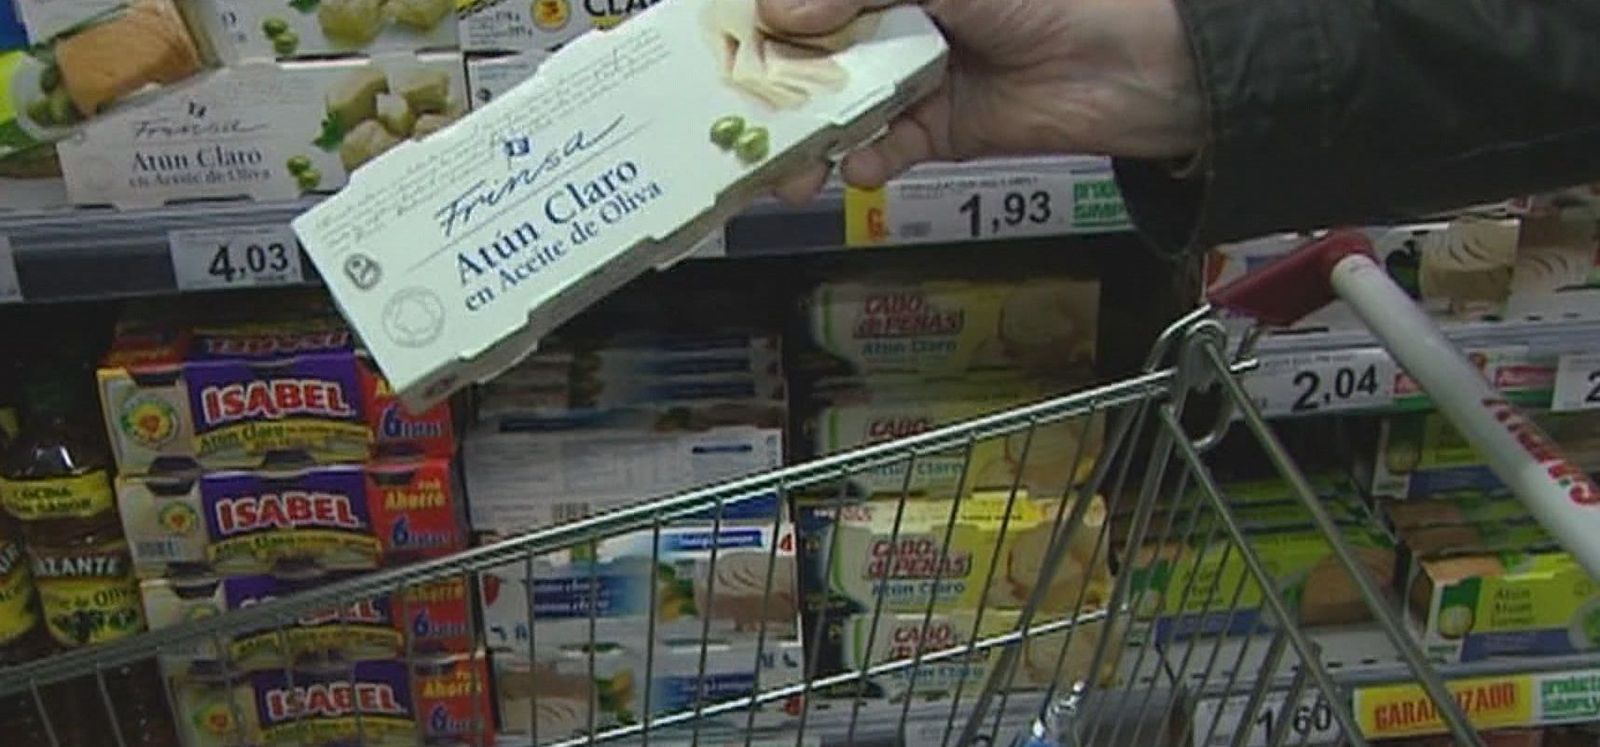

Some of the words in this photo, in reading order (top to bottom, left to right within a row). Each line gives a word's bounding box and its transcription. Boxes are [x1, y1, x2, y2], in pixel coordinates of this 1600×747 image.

[457, 219, 541, 287] Atún
[544, 160, 638, 225] Claro
[958, 189, 1052, 238] 1,93
[208, 242, 290, 282] 4,03
[464, 286, 495, 311] en
[498, 239, 566, 292] Aceite
[569, 219, 598, 246] de
[600, 181, 662, 224] Oliva
[203, 378, 355, 426] ISABEL
[1292, 365, 1378, 412] 2,04
[215, 492, 359, 535] ISABEL
